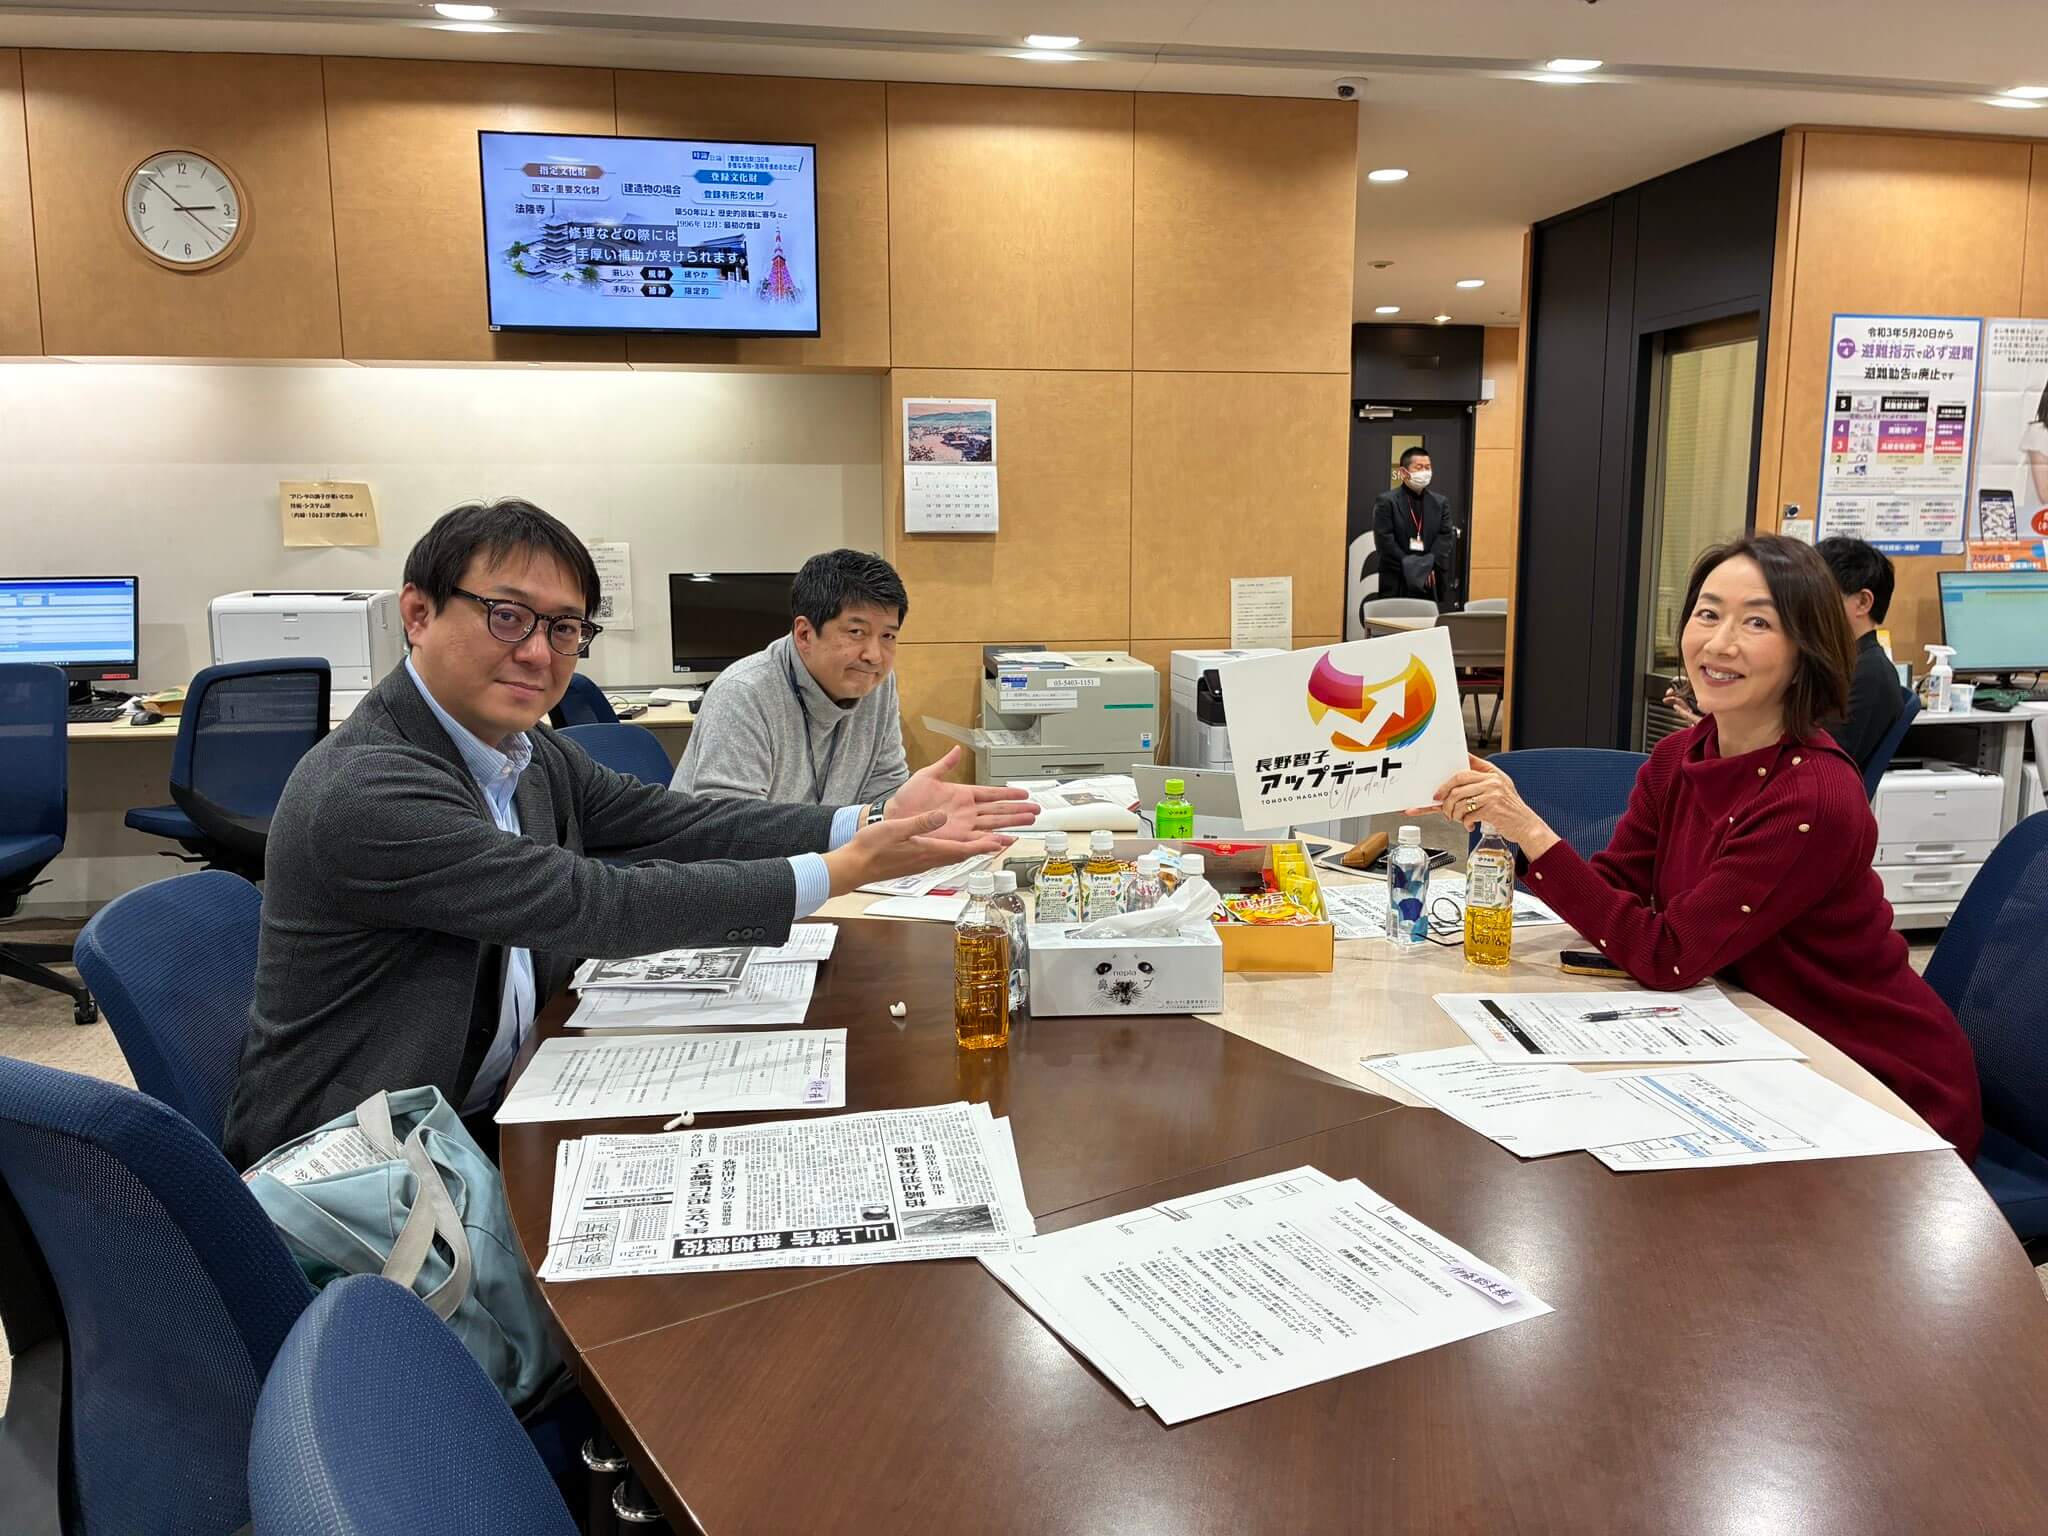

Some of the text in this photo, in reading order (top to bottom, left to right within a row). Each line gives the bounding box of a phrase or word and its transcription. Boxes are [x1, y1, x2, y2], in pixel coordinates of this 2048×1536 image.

[177, 162, 186, 174] 12
[539, 165, 586, 177] 指定文化財
[711, 172, 758, 183] 登録文化財
[624, 183, 682, 196] 建造物の場合
[139, 202, 146, 214] 9
[224, 204, 230, 216] 3
[515, 204, 545, 215] 法隆寺
[568, 228, 678, 242] 修理などの際には
[184, 244, 191, 256] 6
[1868, 328, 1954, 339] 令和3年5月20日から
[1861, 344, 1974, 360] 避難指示で必ず避難
[1864, 367, 1954, 381] 避難勧告は廃止です
[1256, 750, 1330, 772] 長野智子
[1260, 757, 1402, 796] アップデート
[1261, 796, 1293, 805] TOMOKO
[1113, 968, 1136, 977] nepia
[680, 1224, 889, 1257] 山上被告 無期懲役
